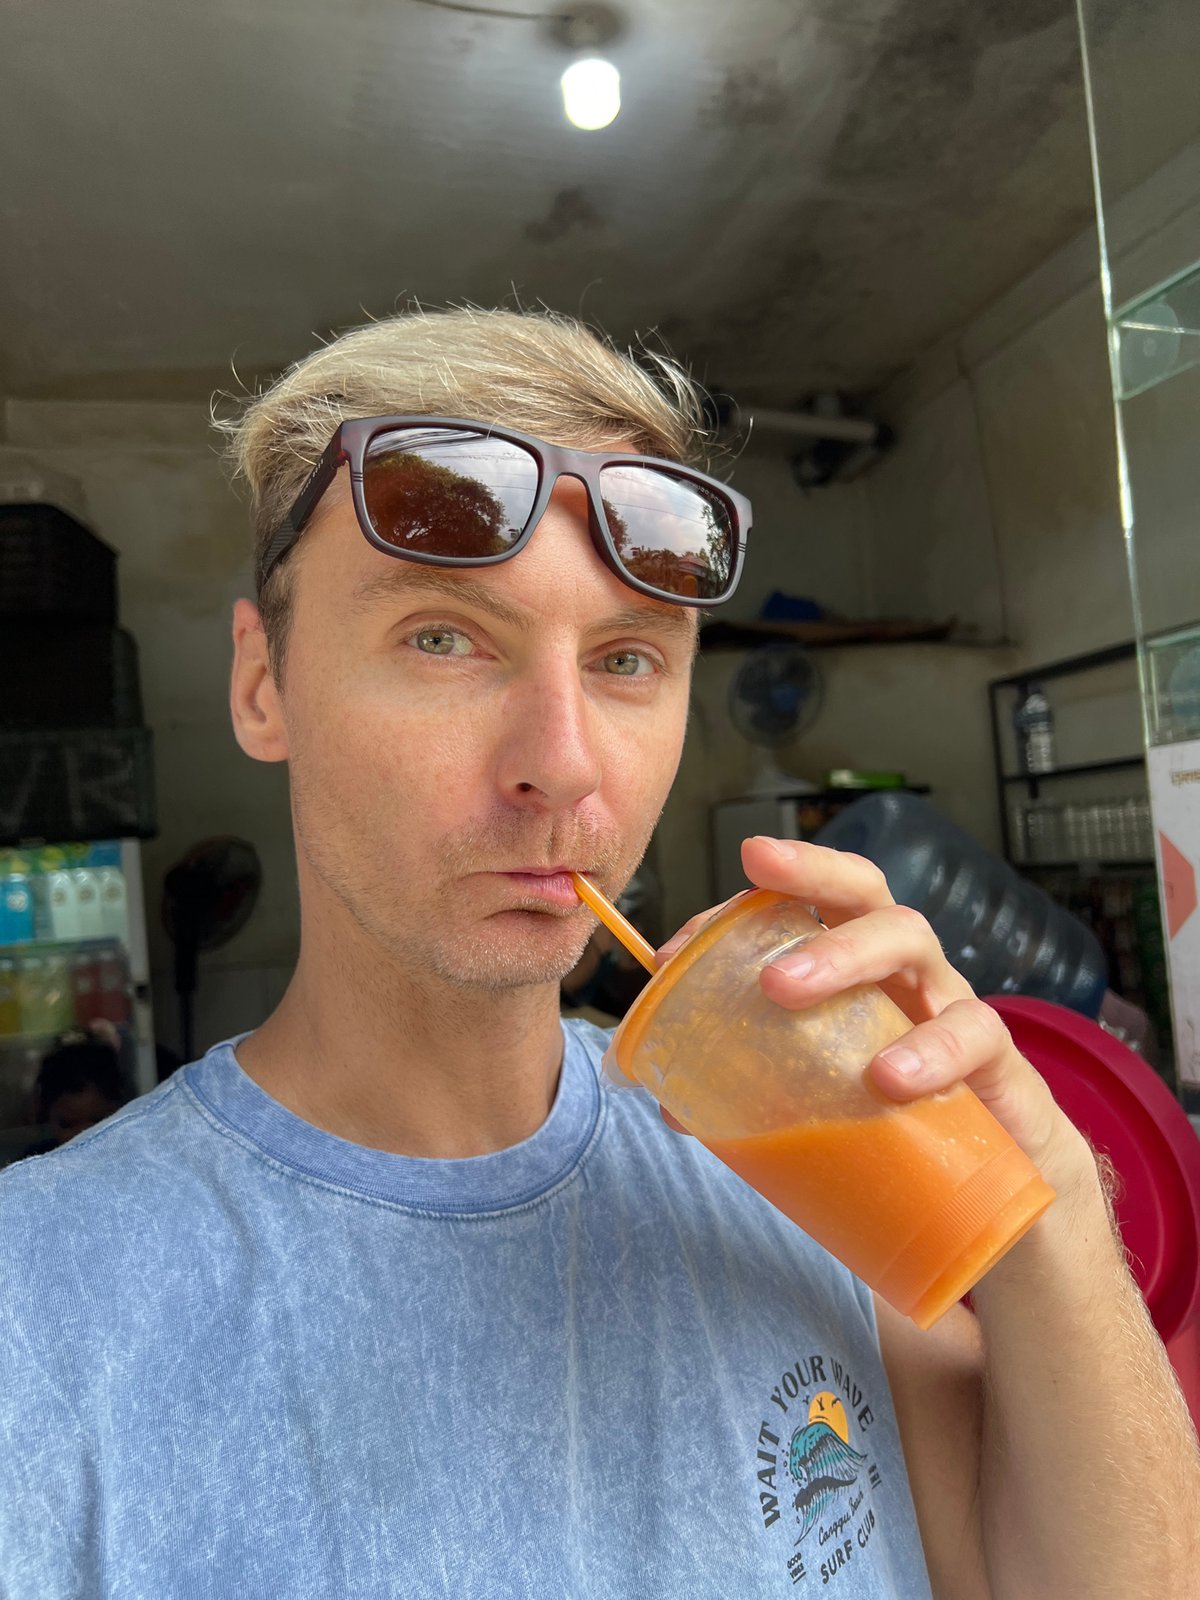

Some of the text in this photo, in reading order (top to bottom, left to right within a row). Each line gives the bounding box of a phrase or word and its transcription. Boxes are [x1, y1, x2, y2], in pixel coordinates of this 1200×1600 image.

[757, 1355, 874, 1529] WAIT YOUR WAVE
[820, 1539, 852, 1585] SURF
[857, 1509, 875, 1548] CLUB
